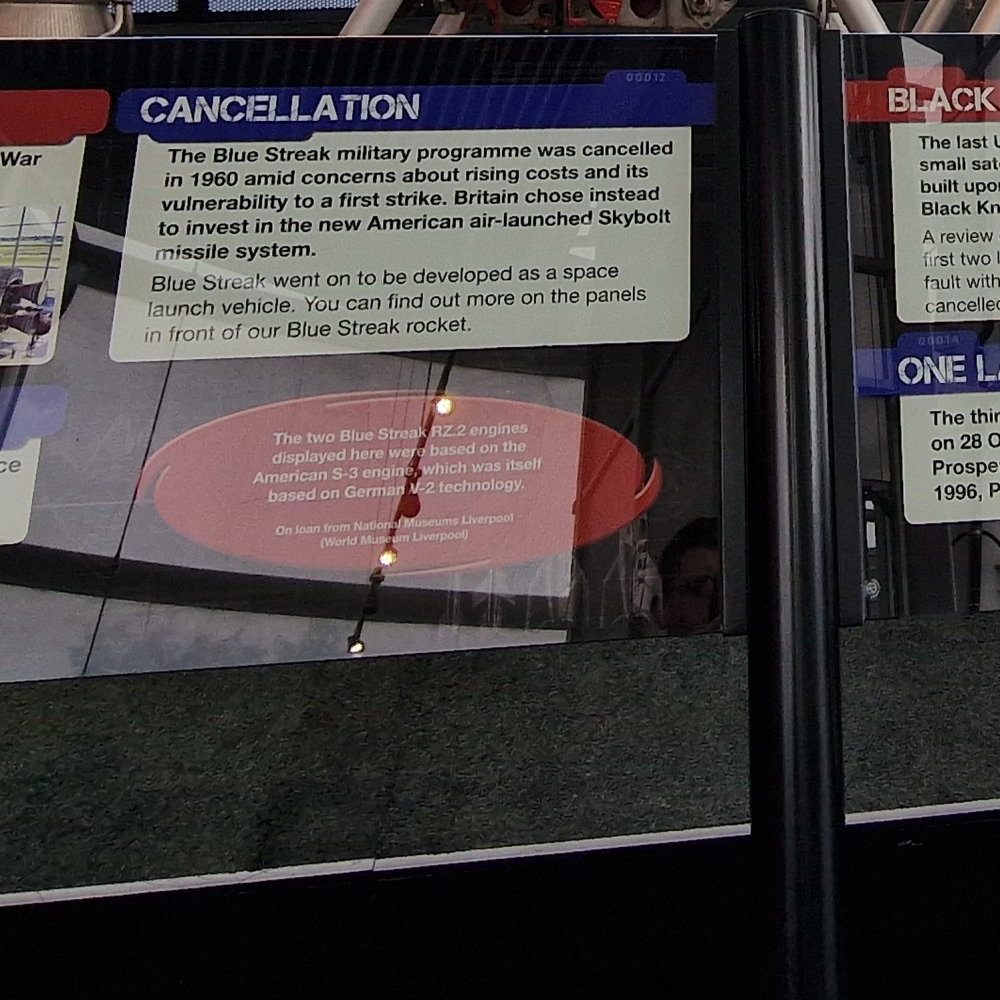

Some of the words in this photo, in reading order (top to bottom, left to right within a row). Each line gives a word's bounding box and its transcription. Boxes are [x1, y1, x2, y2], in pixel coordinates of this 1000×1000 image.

[140, 93, 420, 123] CANCELLATION
[887, 87, 997, 112] BLACK
[167, 148, 206, 163] The
[212, 147, 258, 163] Blue
[264, 145, 330, 162] Streak
[336, 144, 411, 163] military
[416, 145, 532, 163] programme
[536, 145, 576, 157] was
[581, 140, 673, 156] cancelled
[917, 135, 951, 149] The
[956, 134, 988, 149] last
[0, 152, 42, 167] War
[919, 156, 966, 171] small
[164, 172, 183, 187] in
[190, 170, 238, 186] 1960
[243, 169, 295, 186] amid
[300, 171, 396, 184] concerns
[401, 167, 460, 183] about
[465, 165, 519, 184] rising
[525, 165, 579, 180] costs
[583, 163, 620, 179] and
[625, 163, 648, 178] its
[920, 178, 959, 193] built
[161, 193, 288, 212] vulnerability
[293, 193, 314, 208] to
[320, 196, 332, 208] a
[338, 191, 380, 207] first
[385, 190, 447, 206] strike.
[454, 188, 518, 205] Britain
[524, 187, 583, 203] chose
[589, 185, 660, 202] instead
[921, 200, 971, 216] Black
[157, 221, 179, 236] to
[185, 218, 249, 235] invest
[254, 217, 273, 233] in
[279, 217, 312, 232] the
[318, 219, 361, 232] new
[366, 213, 463, 230] American
[469, 209, 592, 228] air-launched
[597, 208, 671, 228] Skybolt
[898, 354, 967, 385] ONE
[928, 409, 964, 426] The
[272, 431, 302, 445] The
[306, 431, 335, 443] two
[339, 428, 374, 442] Blue
[377, 425, 428, 440] Streak
[430, 423, 466, 438] RZ.2
[469, 421, 528, 438] engines
[930, 438, 954, 451] on
[959, 432, 982, 449] 28
[251, 468, 327, 484] American
[330, 466, 358, 480] S-3
[421, 460, 466, 475] which
[470, 462, 501, 473] was
[505, 456, 542, 471] itself
[933, 482, 982, 501] 1996,
